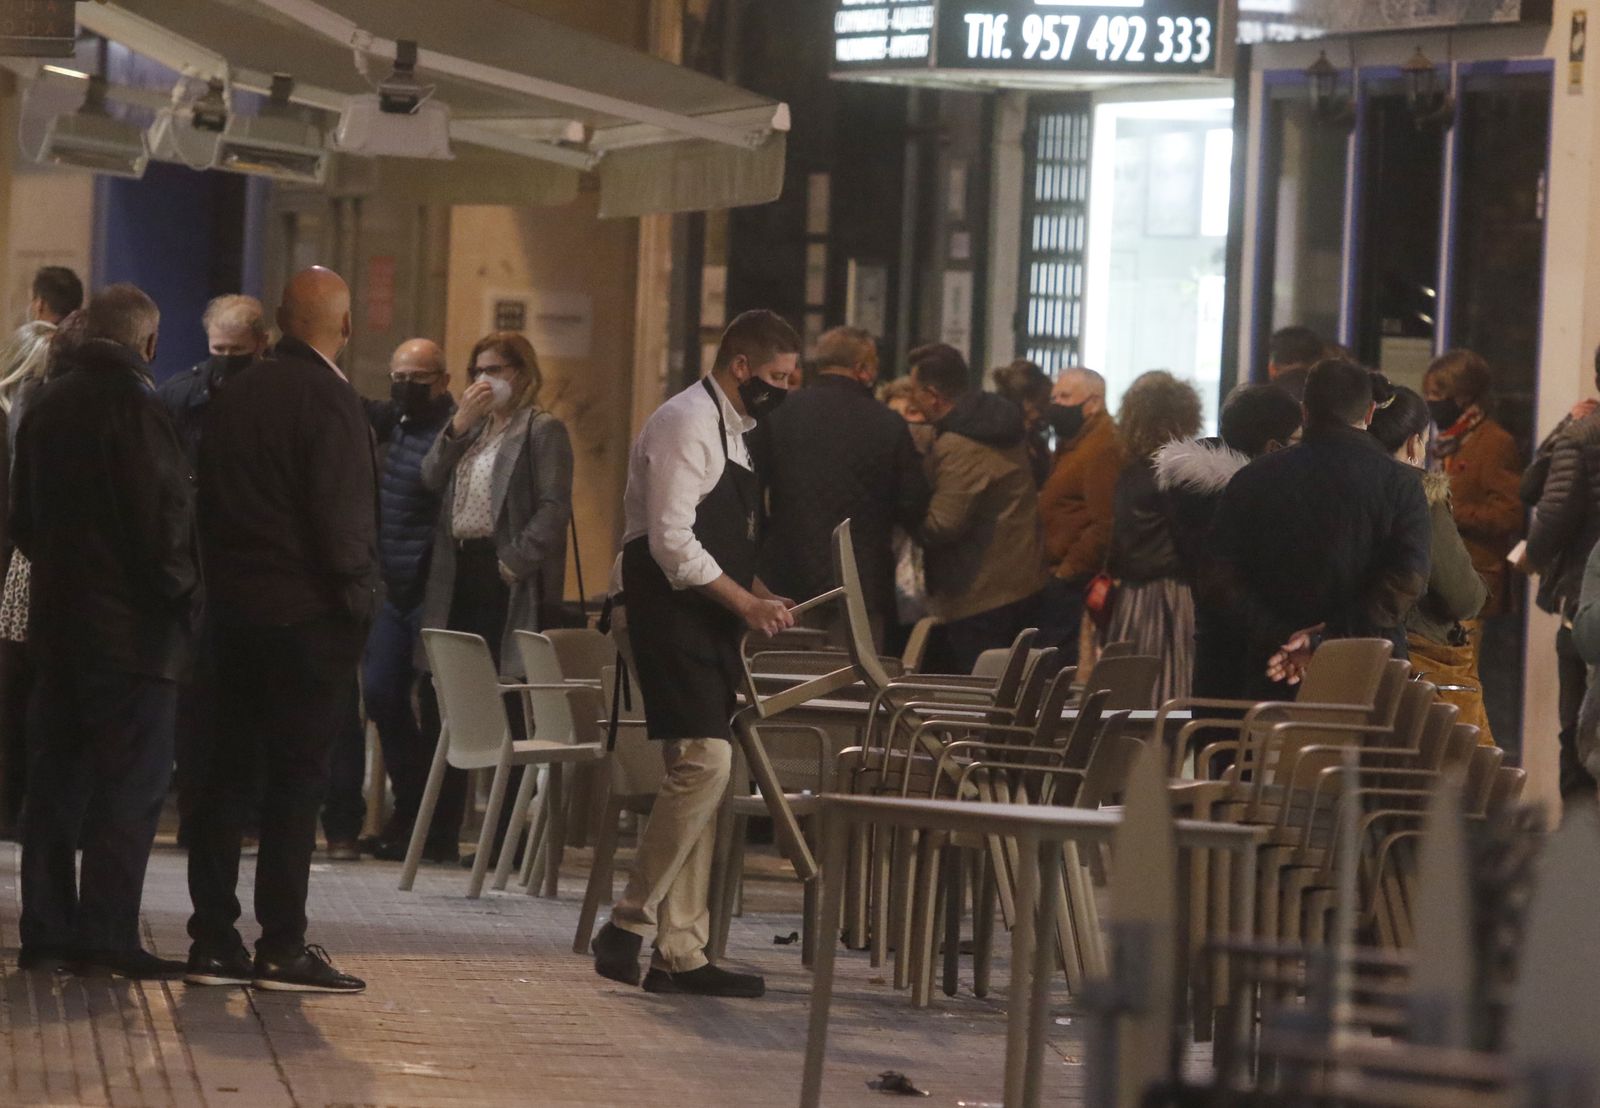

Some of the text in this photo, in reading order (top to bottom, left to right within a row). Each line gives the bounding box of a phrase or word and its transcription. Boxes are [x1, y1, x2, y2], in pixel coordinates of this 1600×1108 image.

[1022, 14, 1081, 60] 957
[1086, 15, 1147, 62] 492
[1154, 16, 1211, 63] 333
